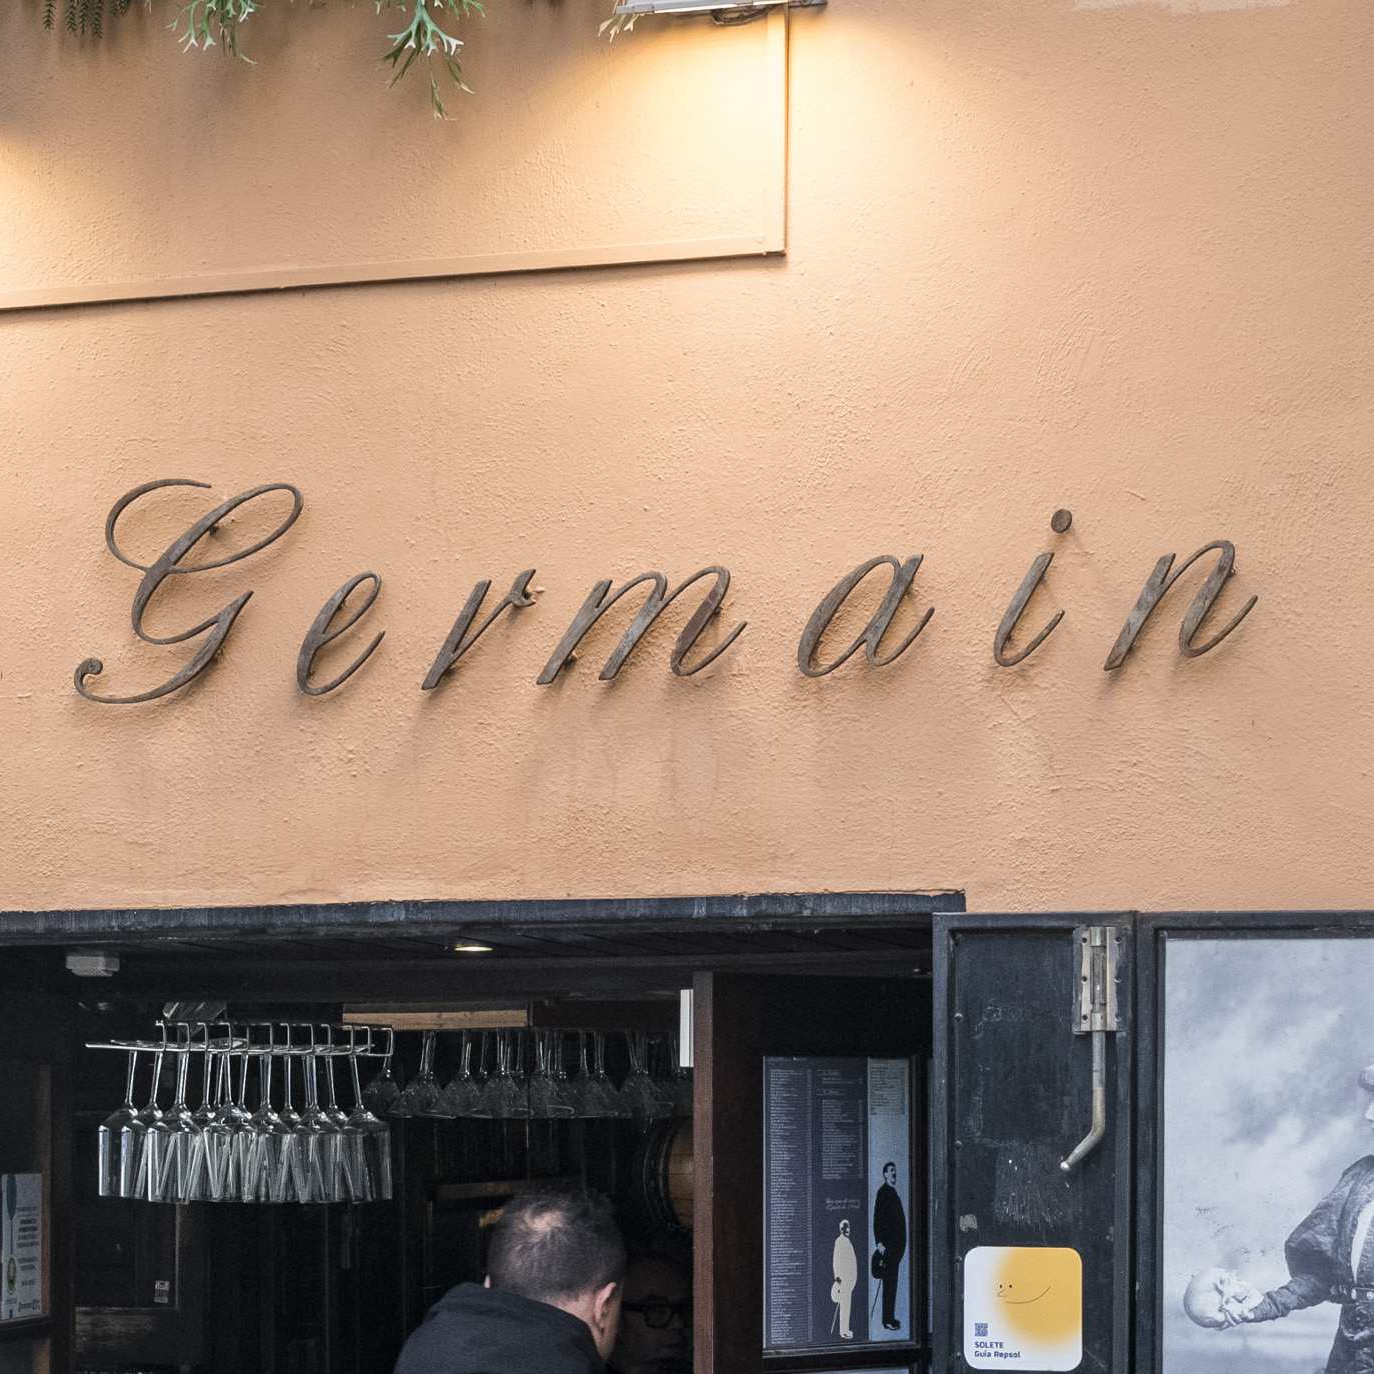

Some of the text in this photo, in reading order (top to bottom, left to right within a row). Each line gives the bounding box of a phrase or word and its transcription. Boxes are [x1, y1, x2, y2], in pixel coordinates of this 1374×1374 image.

[73, 478, 1259, 705] Germain
[974, 1341, 1005, 1350] SOLETE
[993, 1351, 1021, 1360] Repsol
